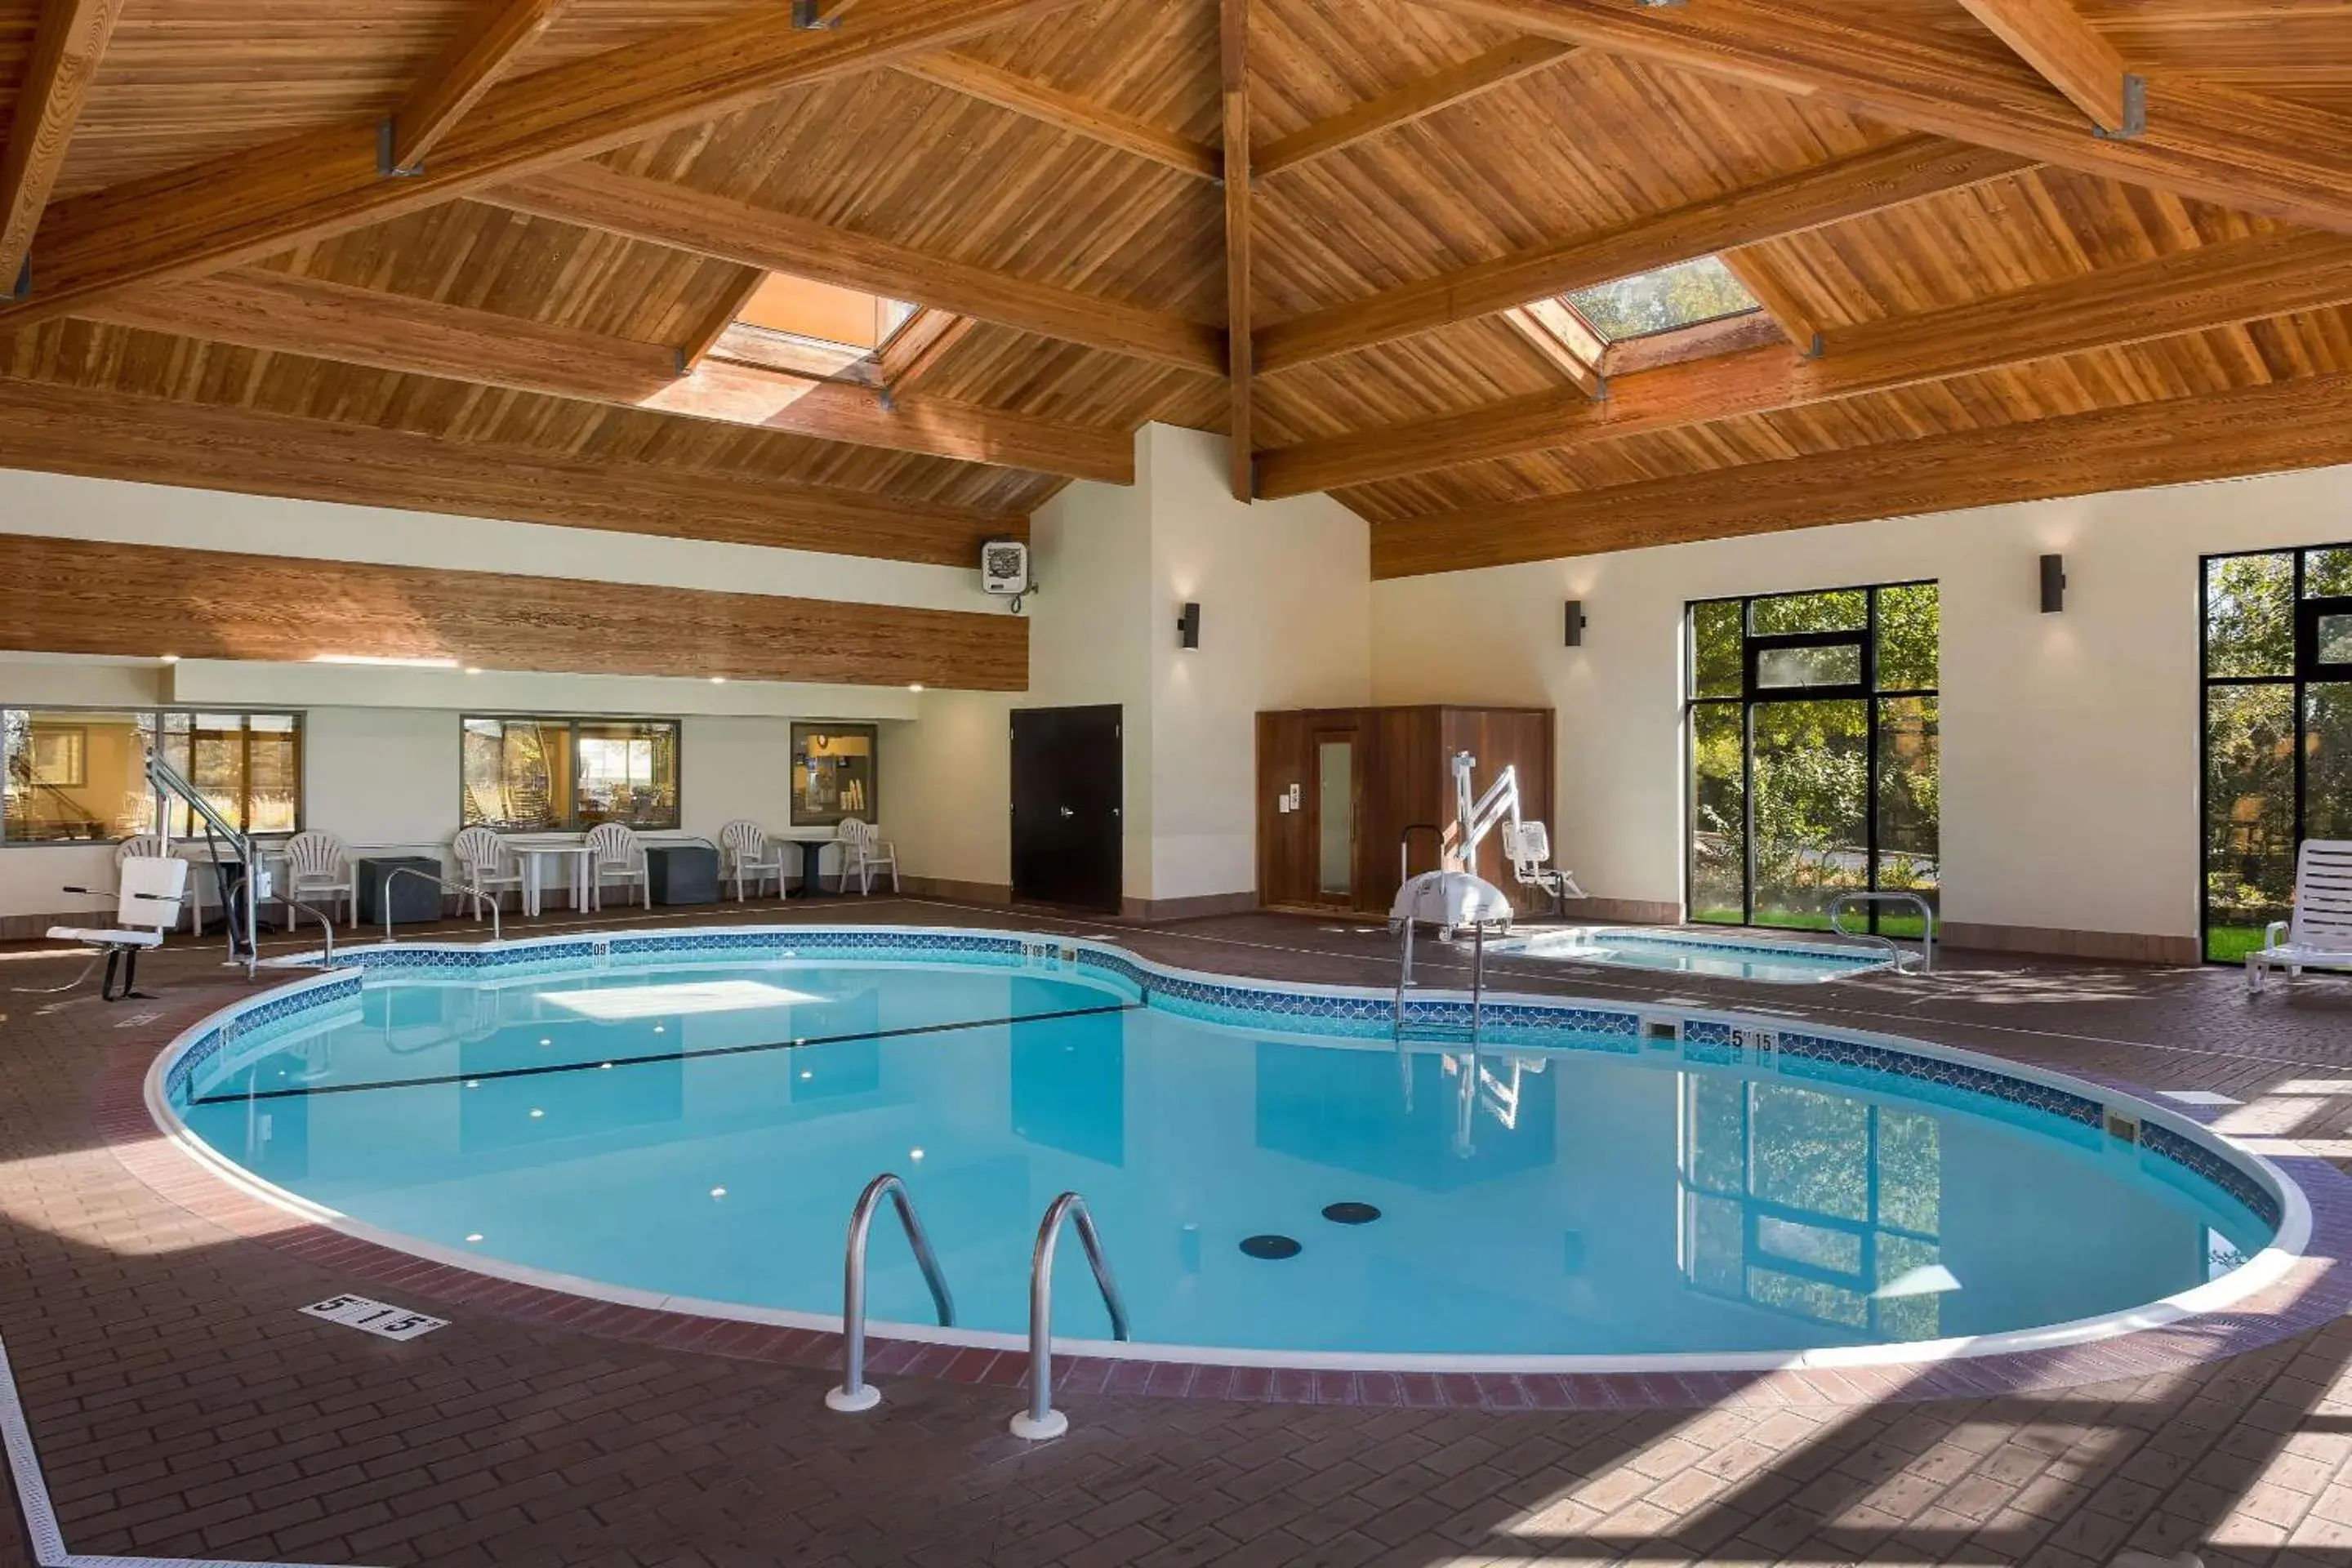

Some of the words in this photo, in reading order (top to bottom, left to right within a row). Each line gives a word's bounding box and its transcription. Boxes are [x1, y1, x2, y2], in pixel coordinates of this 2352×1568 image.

[1732, 1030, 1743, 1047] 5
[1756, 1033, 1771, 1051] 15
[314, 1297, 357, 1311] 5
